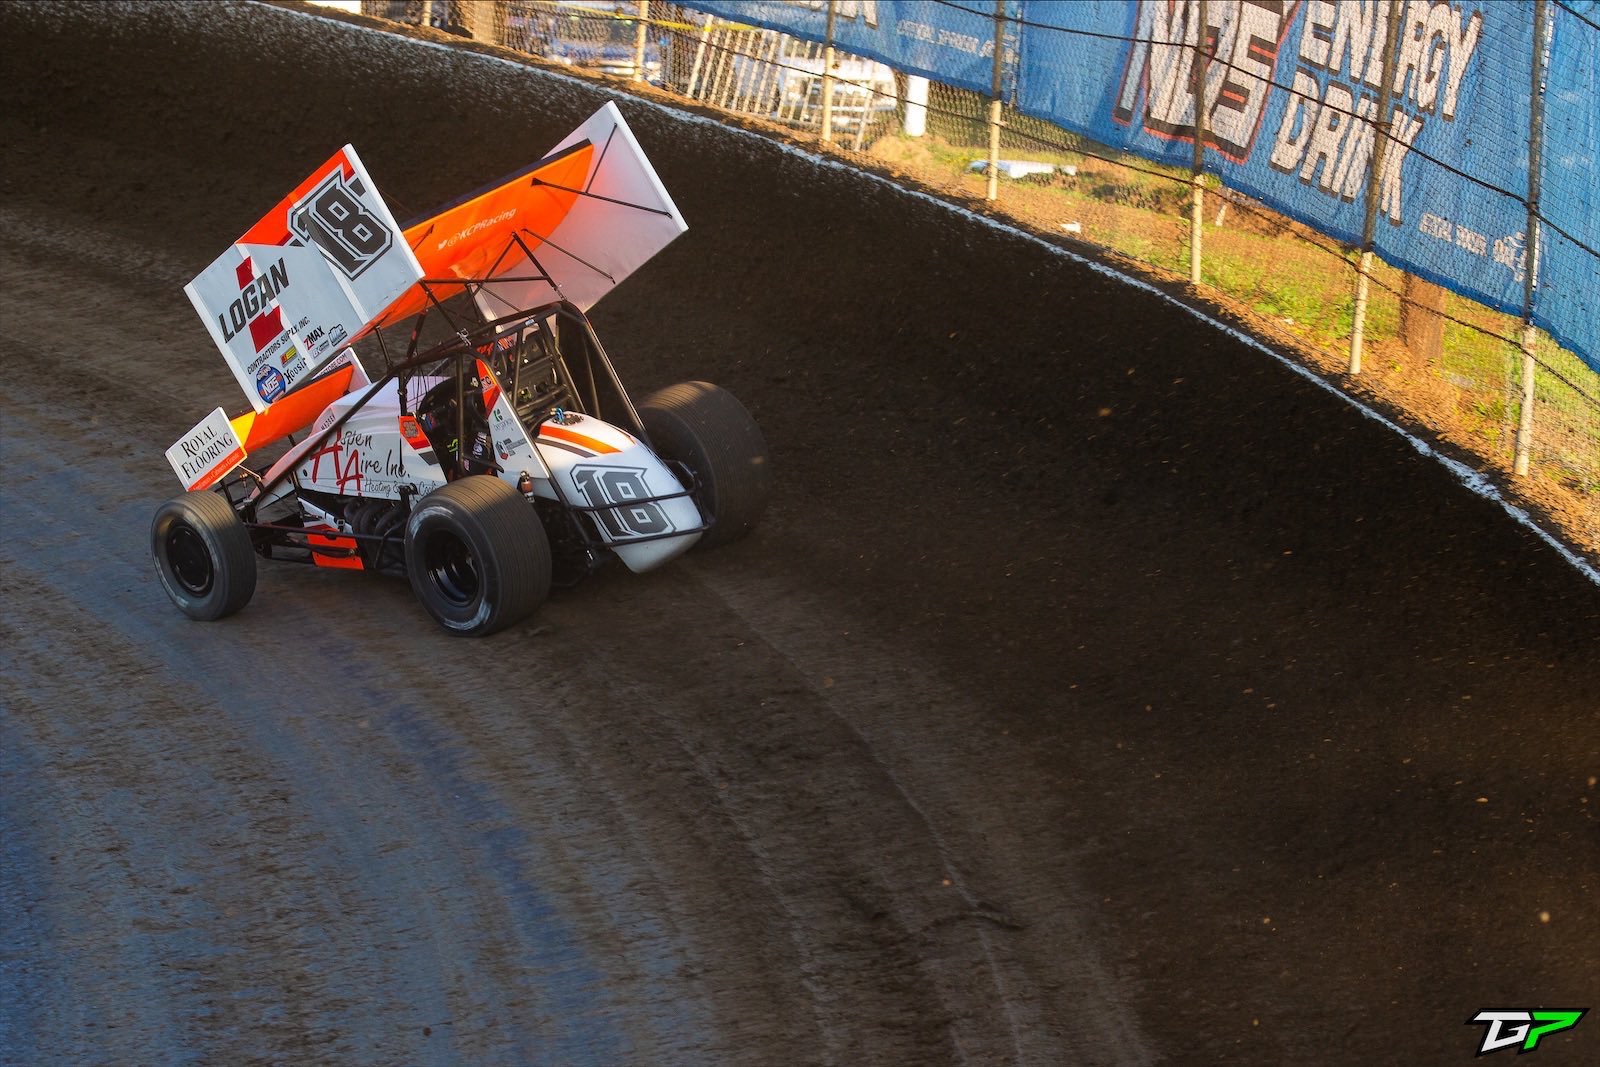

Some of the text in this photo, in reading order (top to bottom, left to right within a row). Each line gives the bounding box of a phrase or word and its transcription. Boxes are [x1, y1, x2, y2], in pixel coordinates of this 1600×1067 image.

[287, 163, 394, 281] 18
[218, 257, 290, 344] LOGAN
[247, 339, 282, 375] CONTRACTORS
[181, 425, 217, 458] ROYAL
[181, 432, 233, 479] FLOORING
[310, 426, 373, 484] Aspen
[336, 449, 410, 496] Aire Inc.
[570, 464, 677, 542] 18
